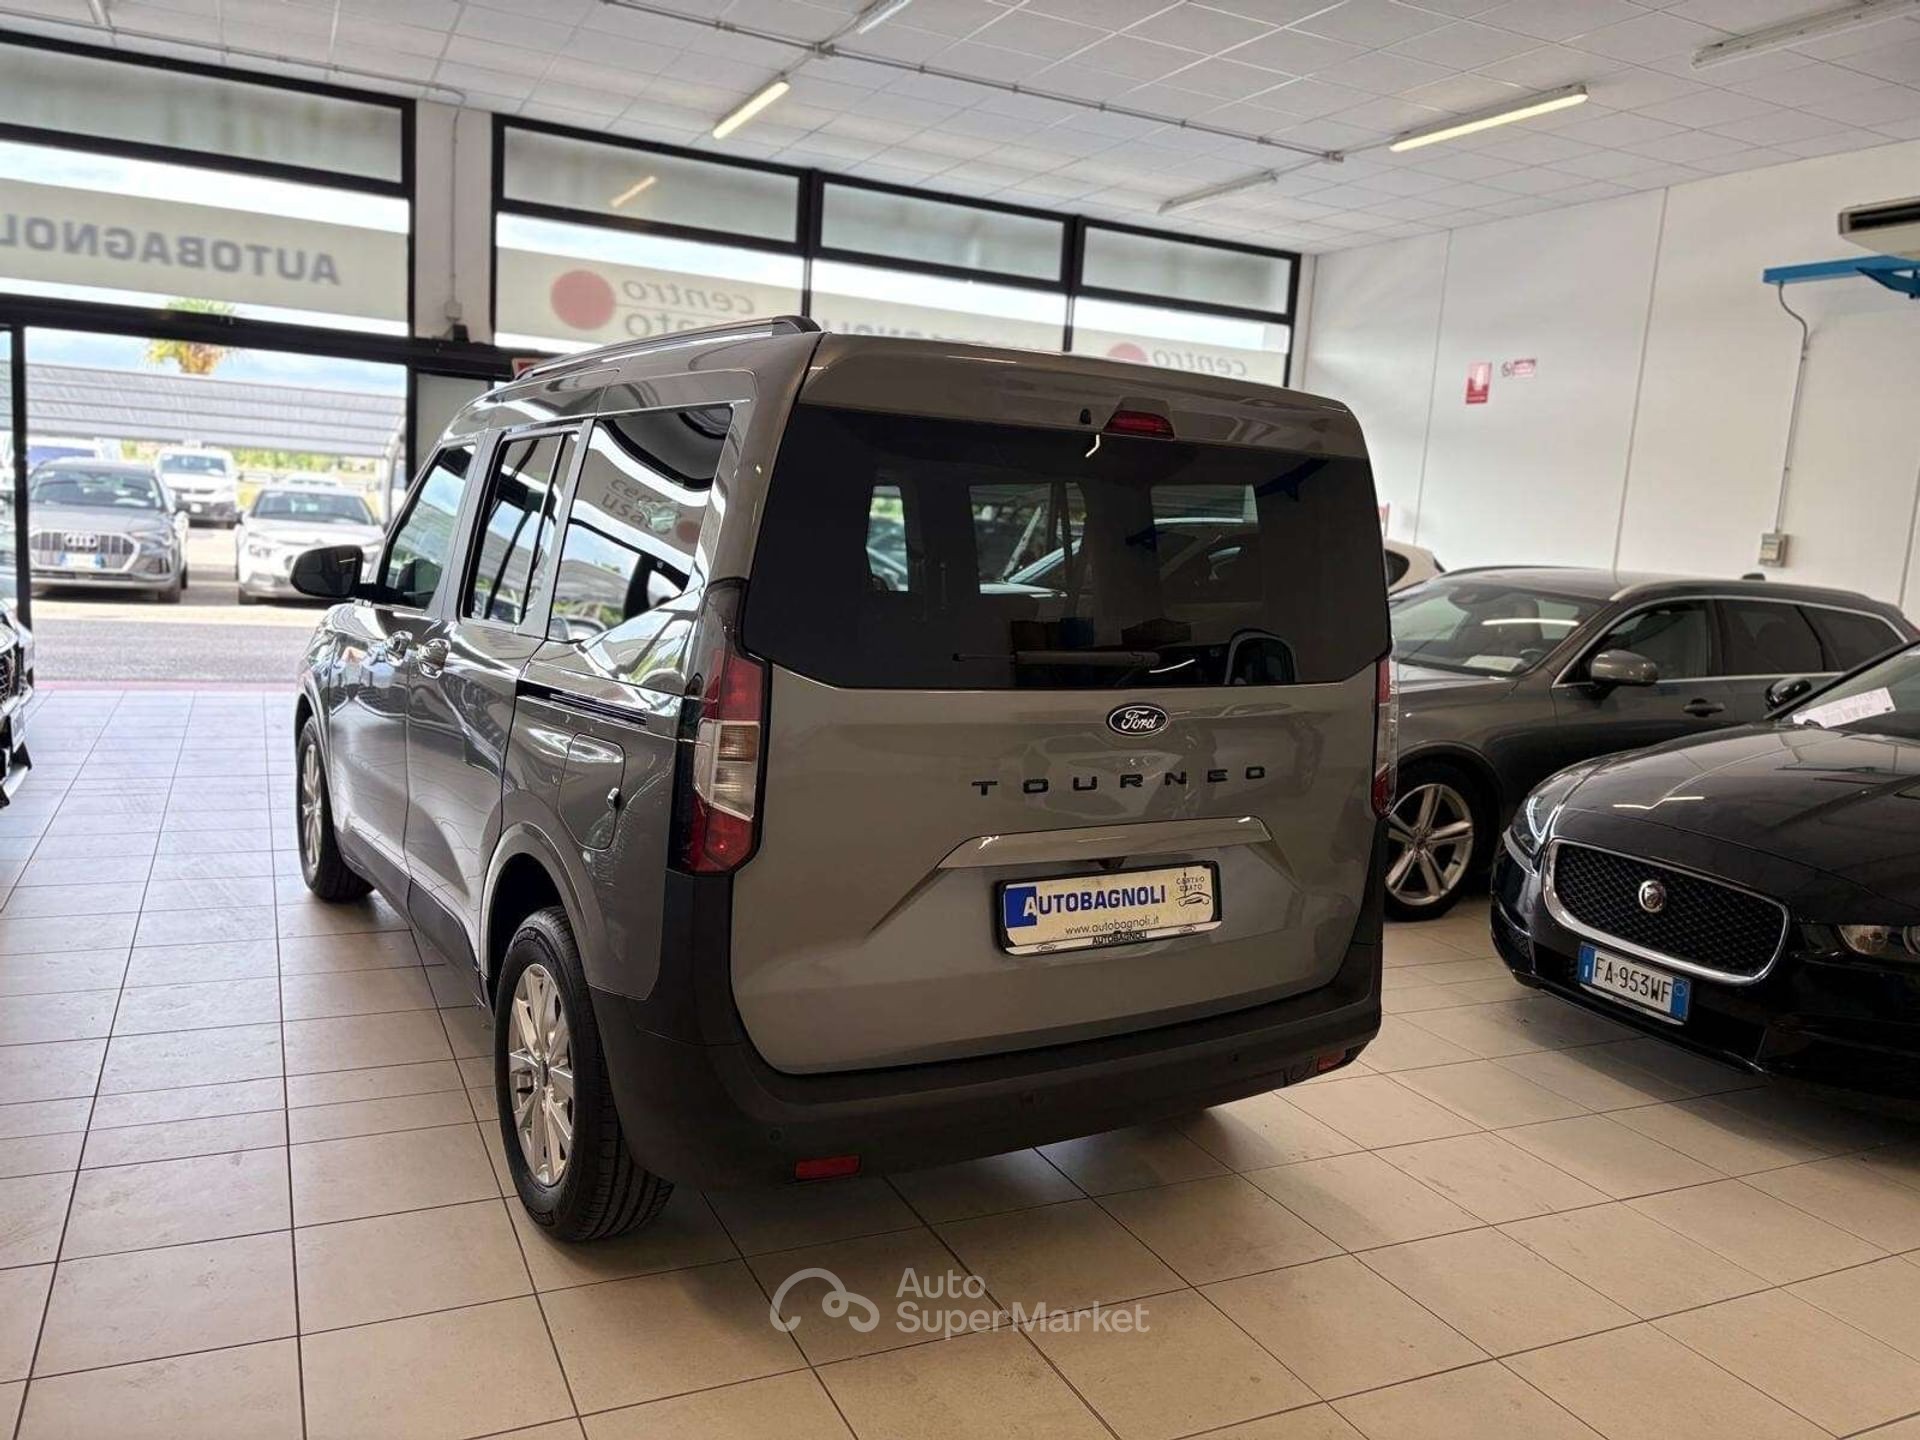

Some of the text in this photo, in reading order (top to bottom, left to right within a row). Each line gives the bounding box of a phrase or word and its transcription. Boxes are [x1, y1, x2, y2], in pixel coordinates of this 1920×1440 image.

[971, 766, 1265, 796] TOURNEO
[1023, 885, 1166, 917] AUTOBAGNOLI
[1065, 915, 1160, 935] www.autobagnoli.it
